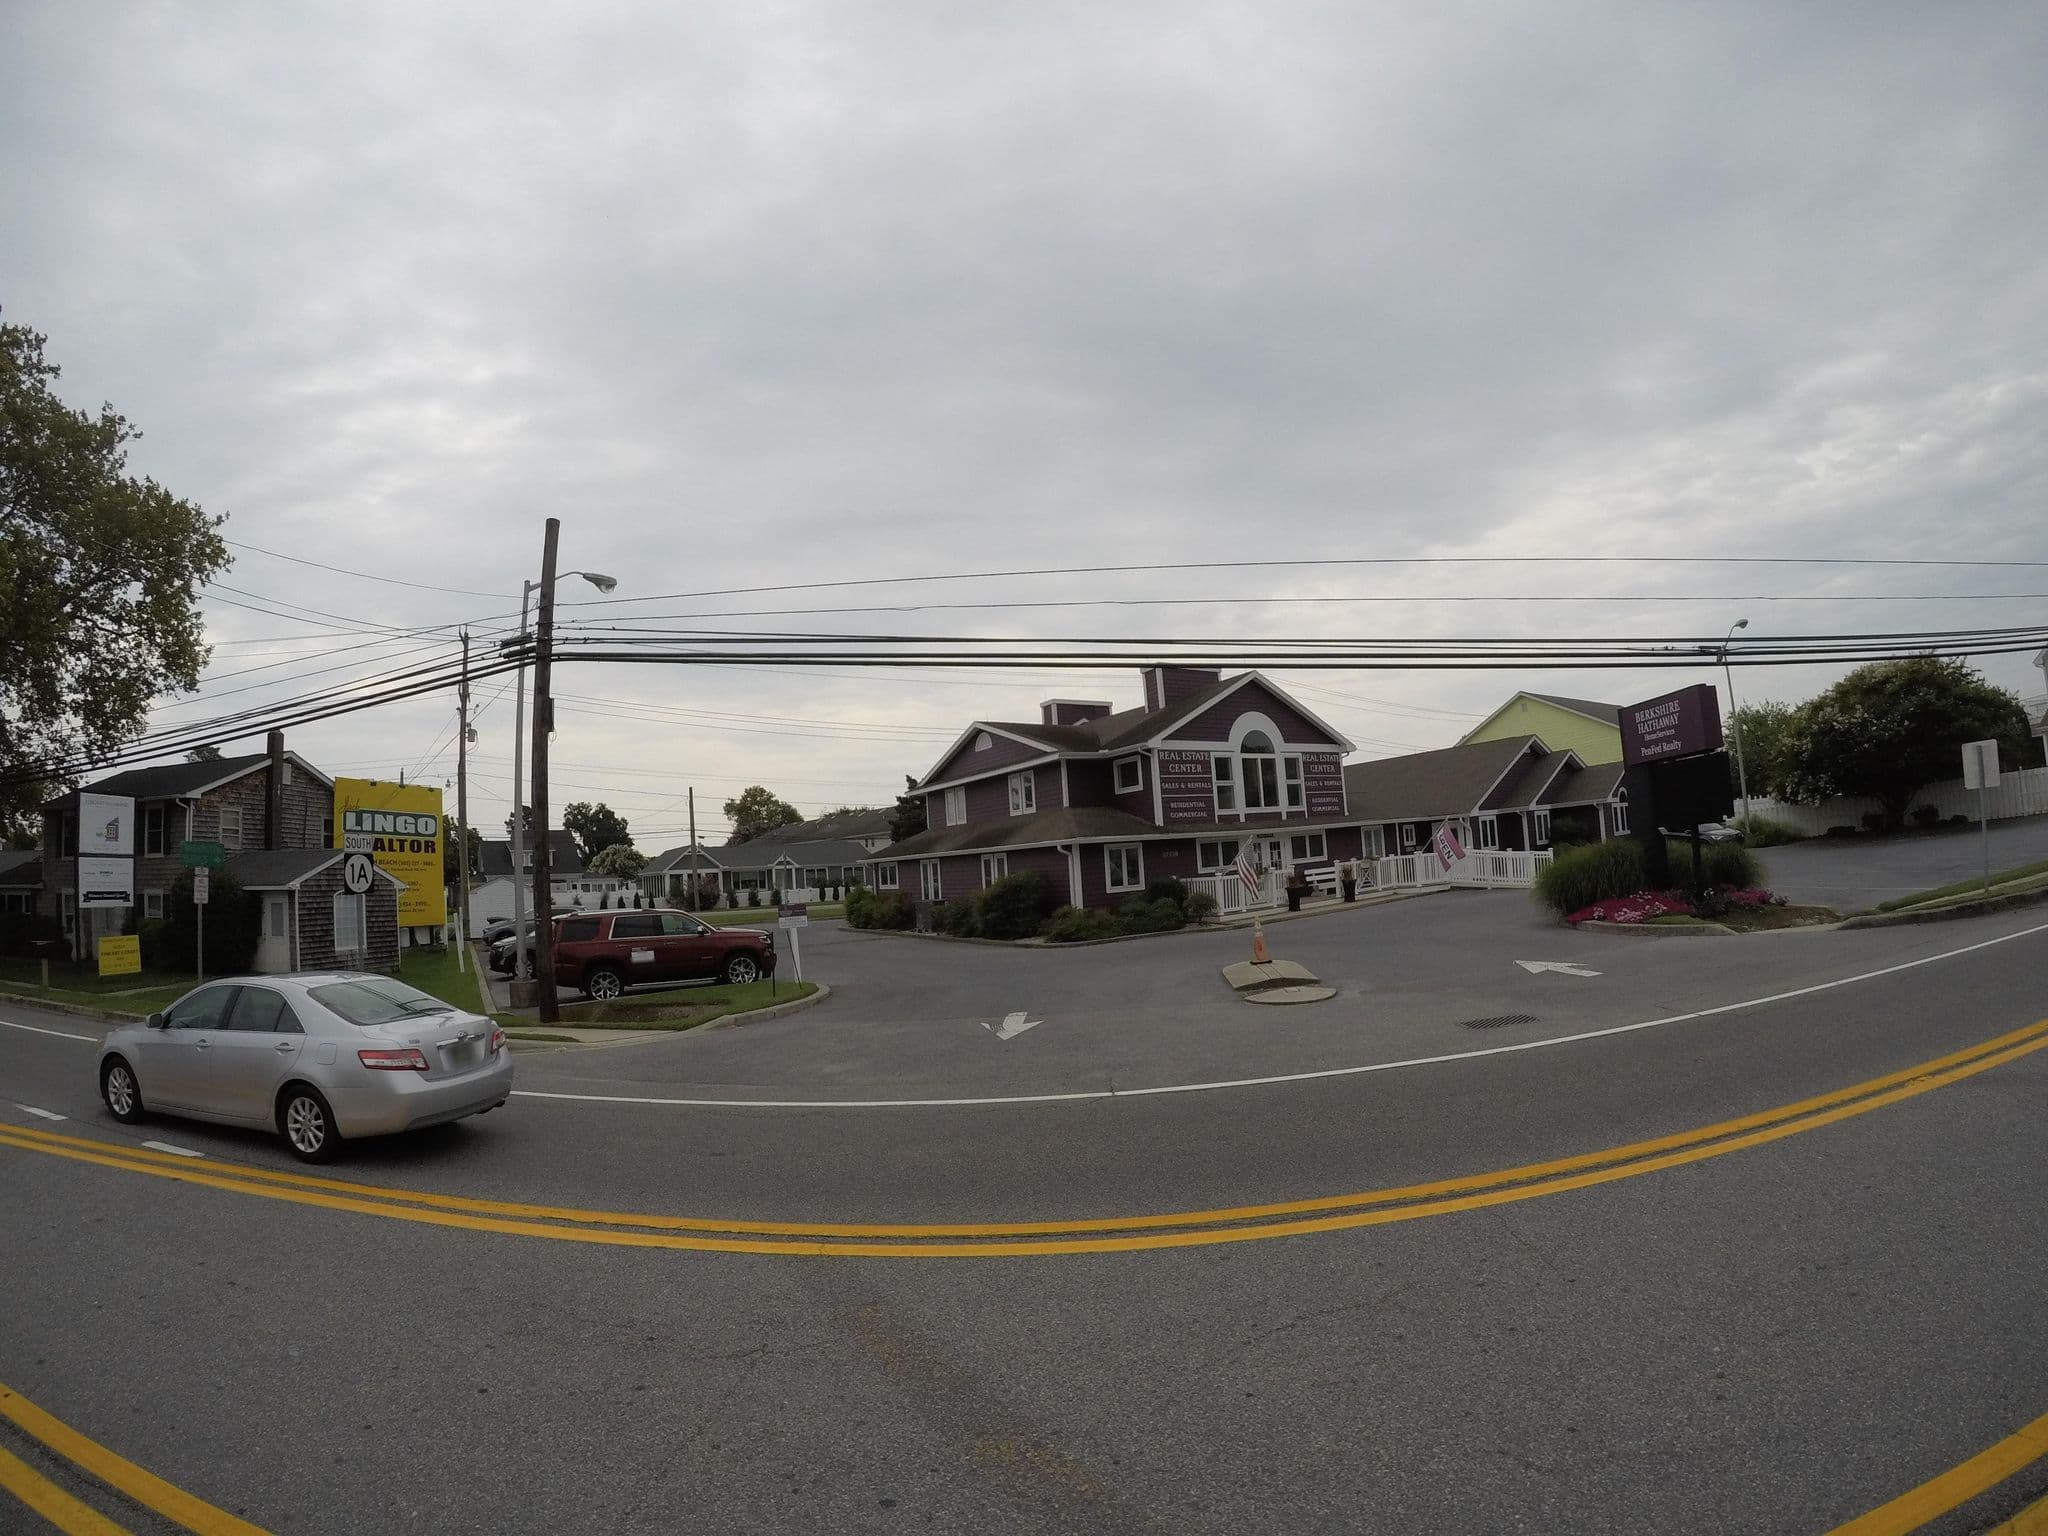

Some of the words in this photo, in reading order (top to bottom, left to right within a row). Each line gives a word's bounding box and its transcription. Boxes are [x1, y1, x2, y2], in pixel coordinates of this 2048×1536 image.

[1635, 700, 1681, 723] BERKSHIRE
[1637, 713, 1680, 734] HATHAWAY
[1644, 728, 1675, 741] HomeServices
[1641, 743, 1662, 757] PenFed
[1663, 740, 1682, 752] Realty
[1159, 751, 1181, 761] REAL
[1182, 751, 1210, 761] ESTATE
[1303, 753, 1319, 762] REAL
[1320, 753, 1340, 762] ESTATE
[1168, 763, 1203, 773] CENTER
[1310, 764, 1336, 773] CENTER
[345, 811, 436, 835] LINGO
[345, 837, 371, 850] SOUTH
[372, 838, 436, 854] ALTOR
[350, 862, 369, 884] 1A
